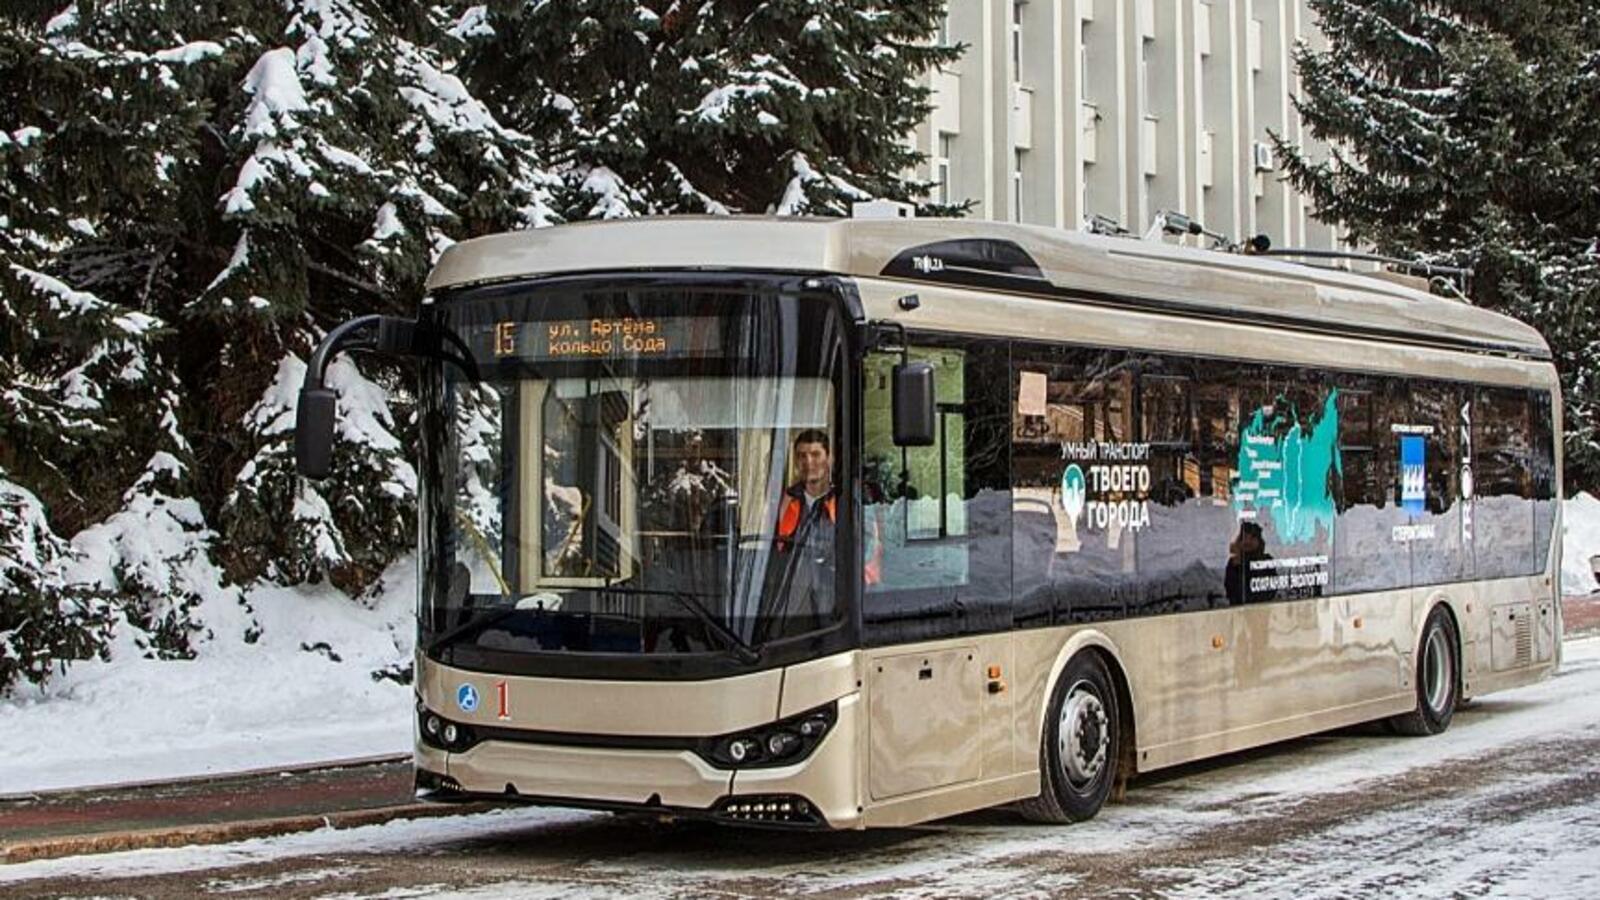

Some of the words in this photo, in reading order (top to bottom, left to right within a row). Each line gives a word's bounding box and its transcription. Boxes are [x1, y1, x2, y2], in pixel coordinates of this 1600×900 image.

[495, 322, 515, 353] 15
[549, 323, 579, 338] ул.
[591, 318, 655, 336] Артёма
[549, 339, 612, 354] кольцо
[623, 335, 666, 352] Сода
[1061, 439, 1096, 459] УМНЫЙ
[1098, 440, 1149, 459] ТРАНСПОРТ
[1090, 465, 1150, 491] ТВОЕГО
[1087, 500, 1150, 532] ГОРОДА
[496, 680, 510, 720] 1
